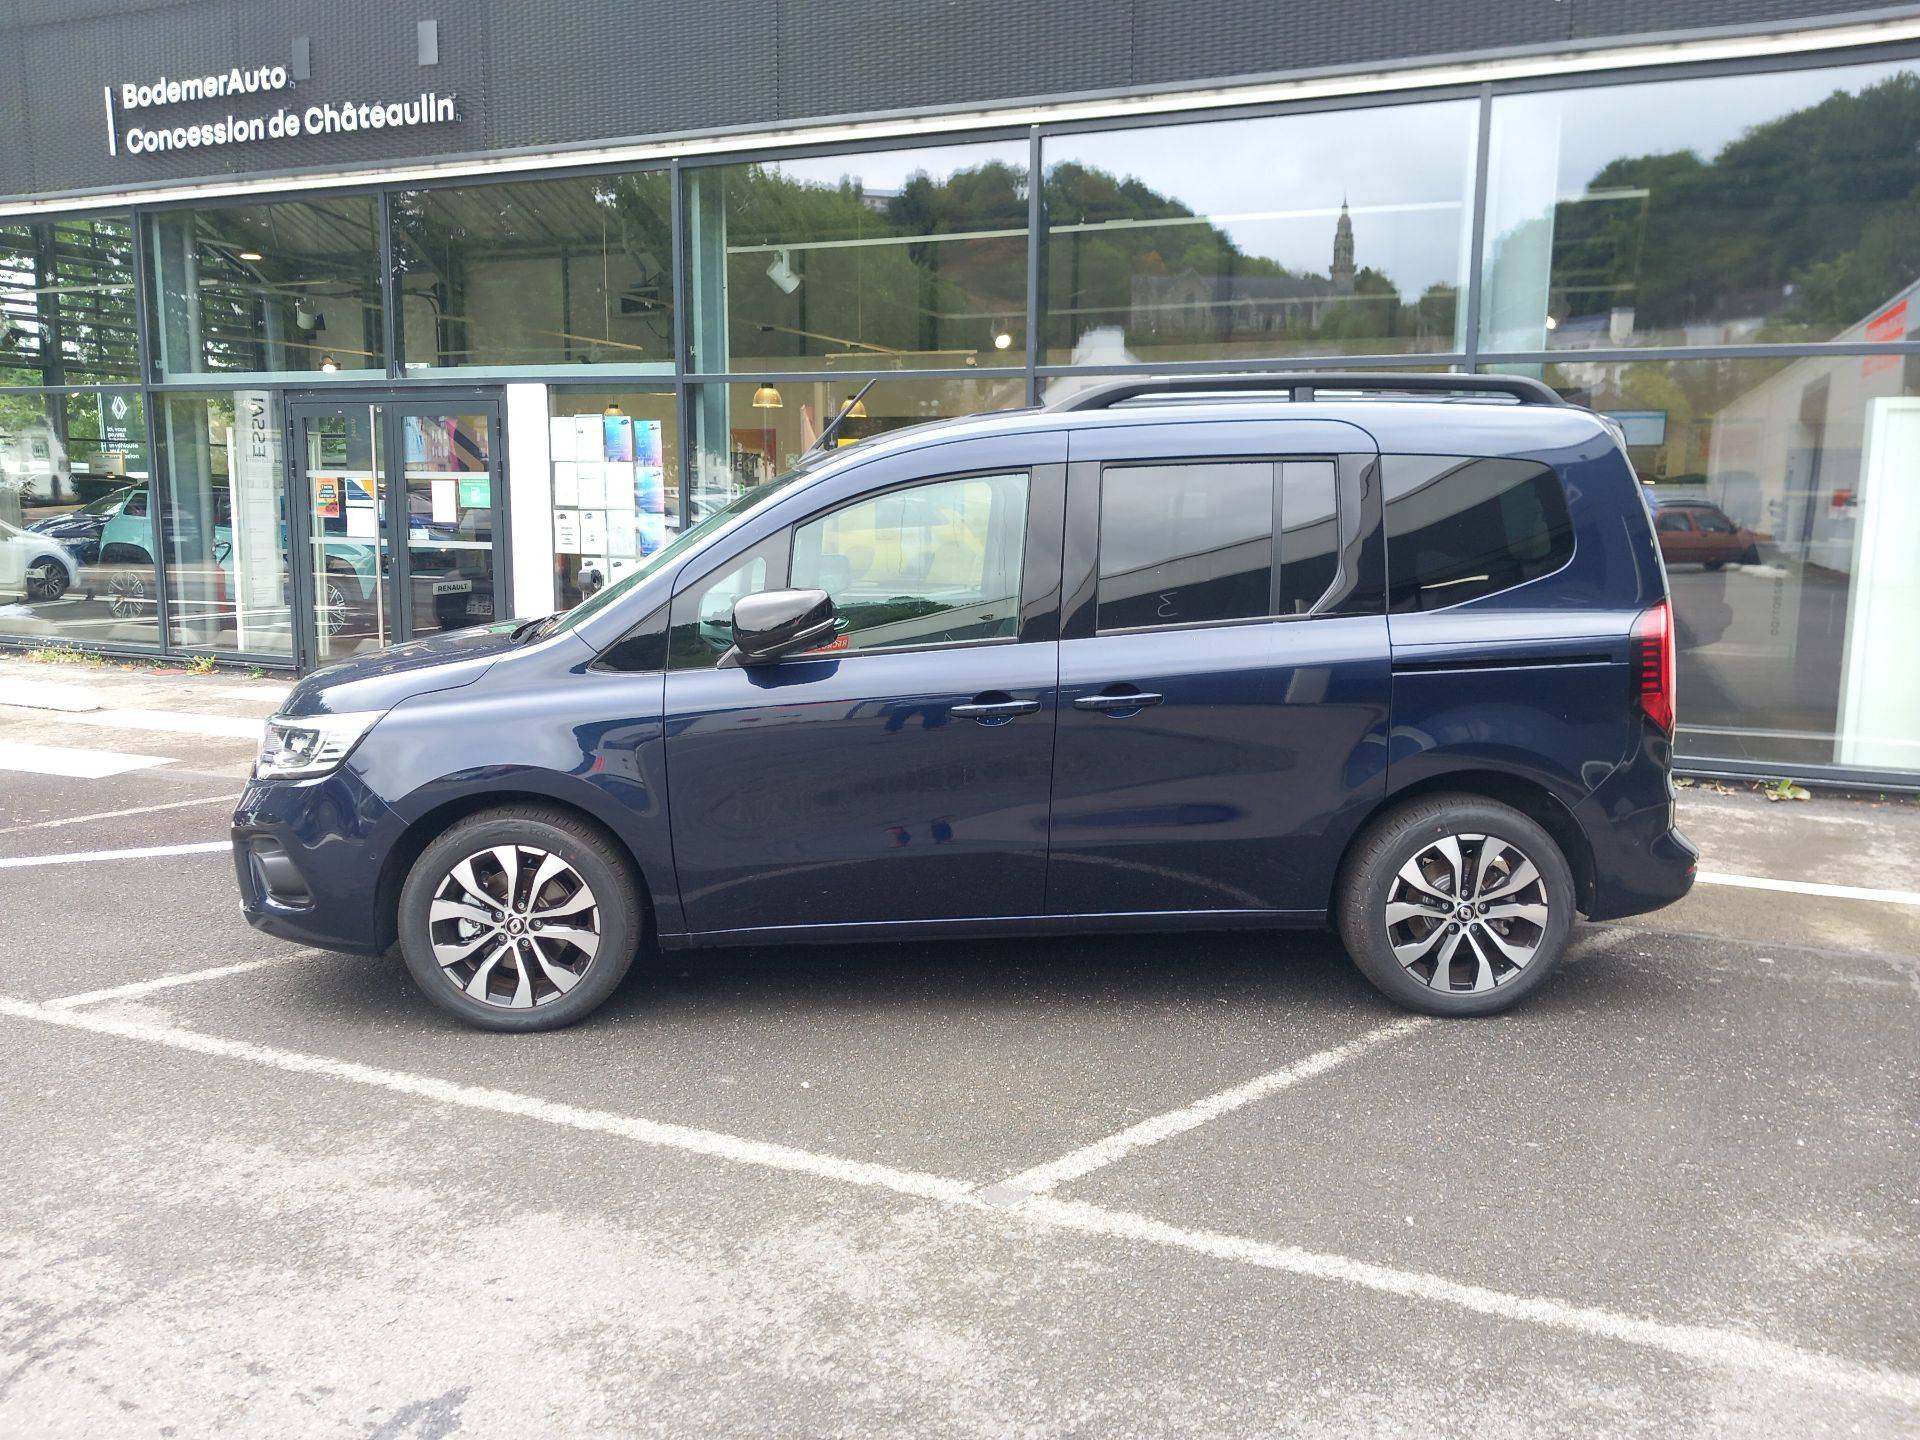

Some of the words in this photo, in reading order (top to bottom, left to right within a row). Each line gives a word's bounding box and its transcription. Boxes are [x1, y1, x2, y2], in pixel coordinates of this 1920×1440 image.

[122, 66, 286, 109] BodemerAuto
[126, 116, 264, 154] Concession
[268, 109, 300, 139] de
[304, 93, 454, 135] Châteaulin
[437, 582, 468, 593] RENAULT
